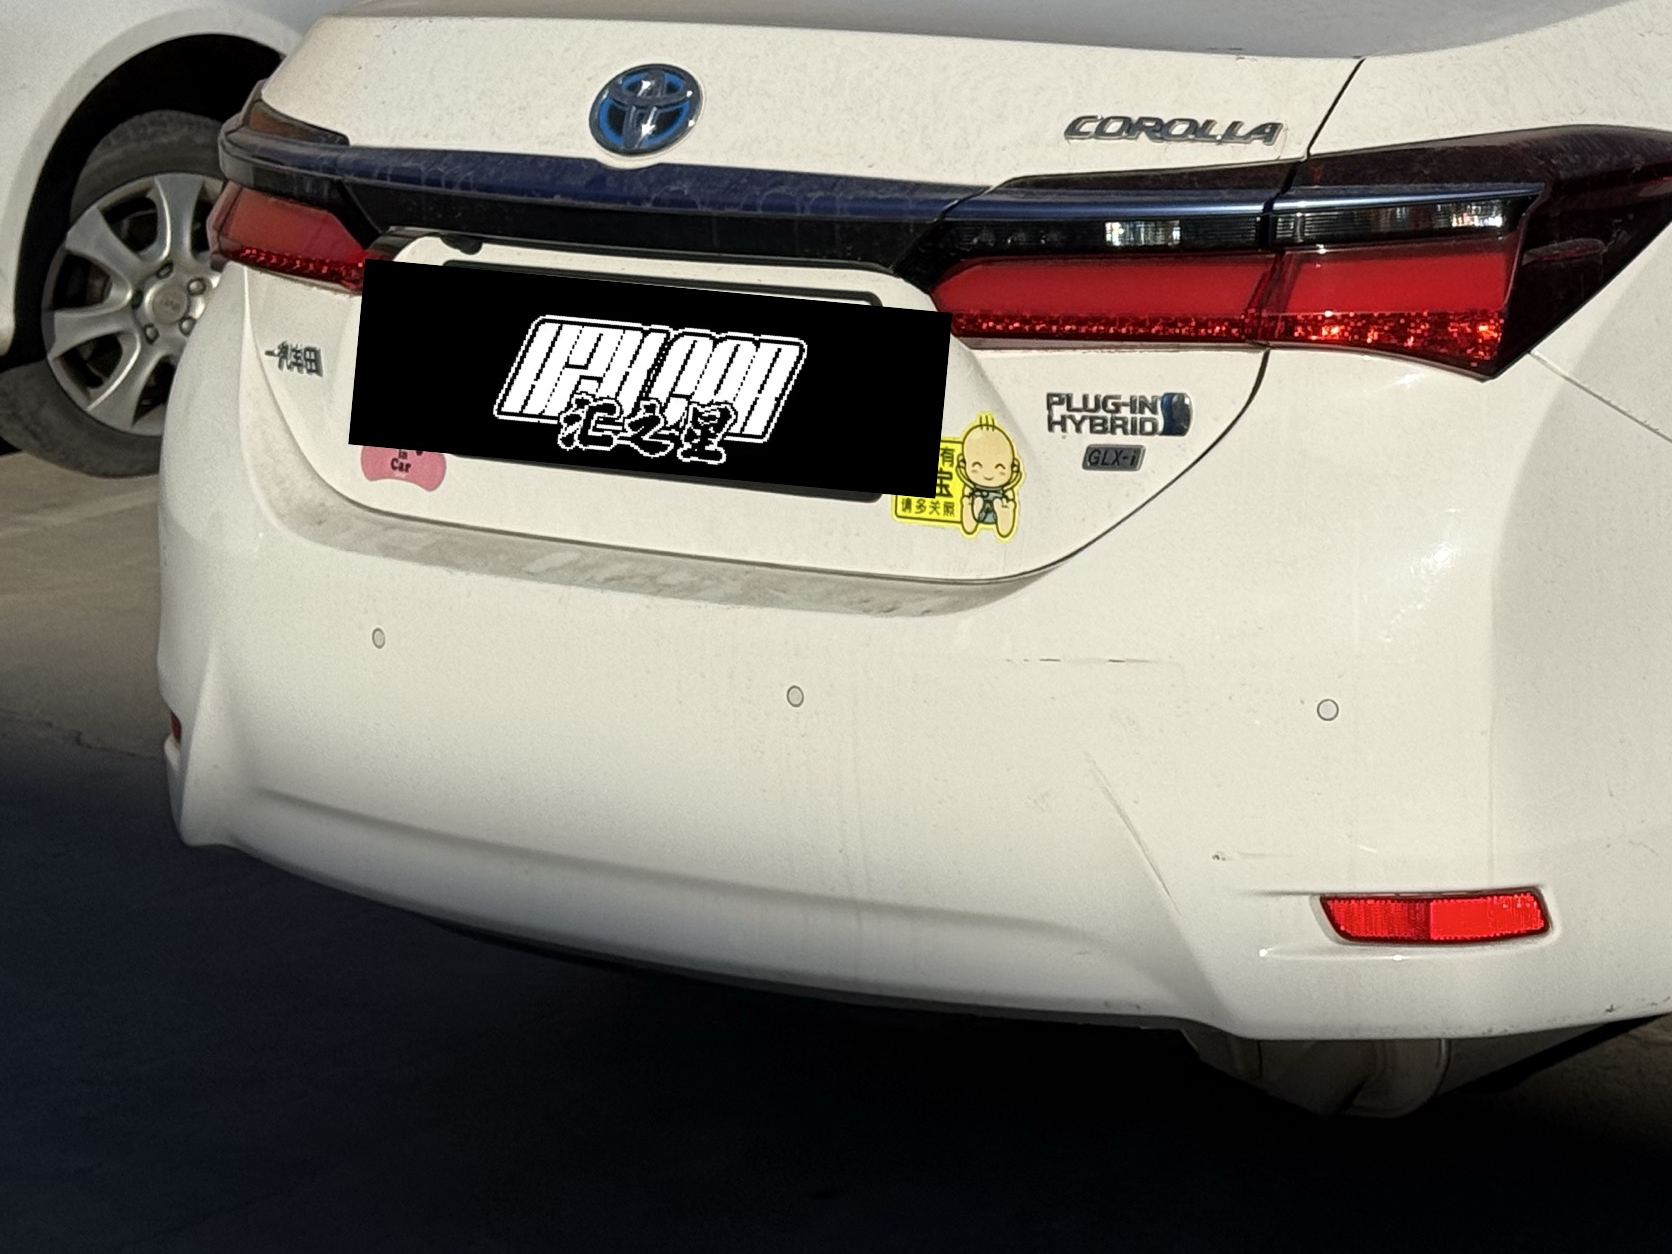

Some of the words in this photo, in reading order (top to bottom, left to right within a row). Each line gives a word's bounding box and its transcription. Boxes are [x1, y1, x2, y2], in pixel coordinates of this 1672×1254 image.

[1064, 115, 1284, 146] COROLLA
[265, 340, 323, 377] 一汽丰田
[1046, 392, 1160, 415] PLUG-IN
[1047, 414, 1160, 436] HYBRID
[390, 457, 412, 473] Car
[1087, 448, 1138, 468] GLX-i
[901, 497, 955, 518] 请多关照
